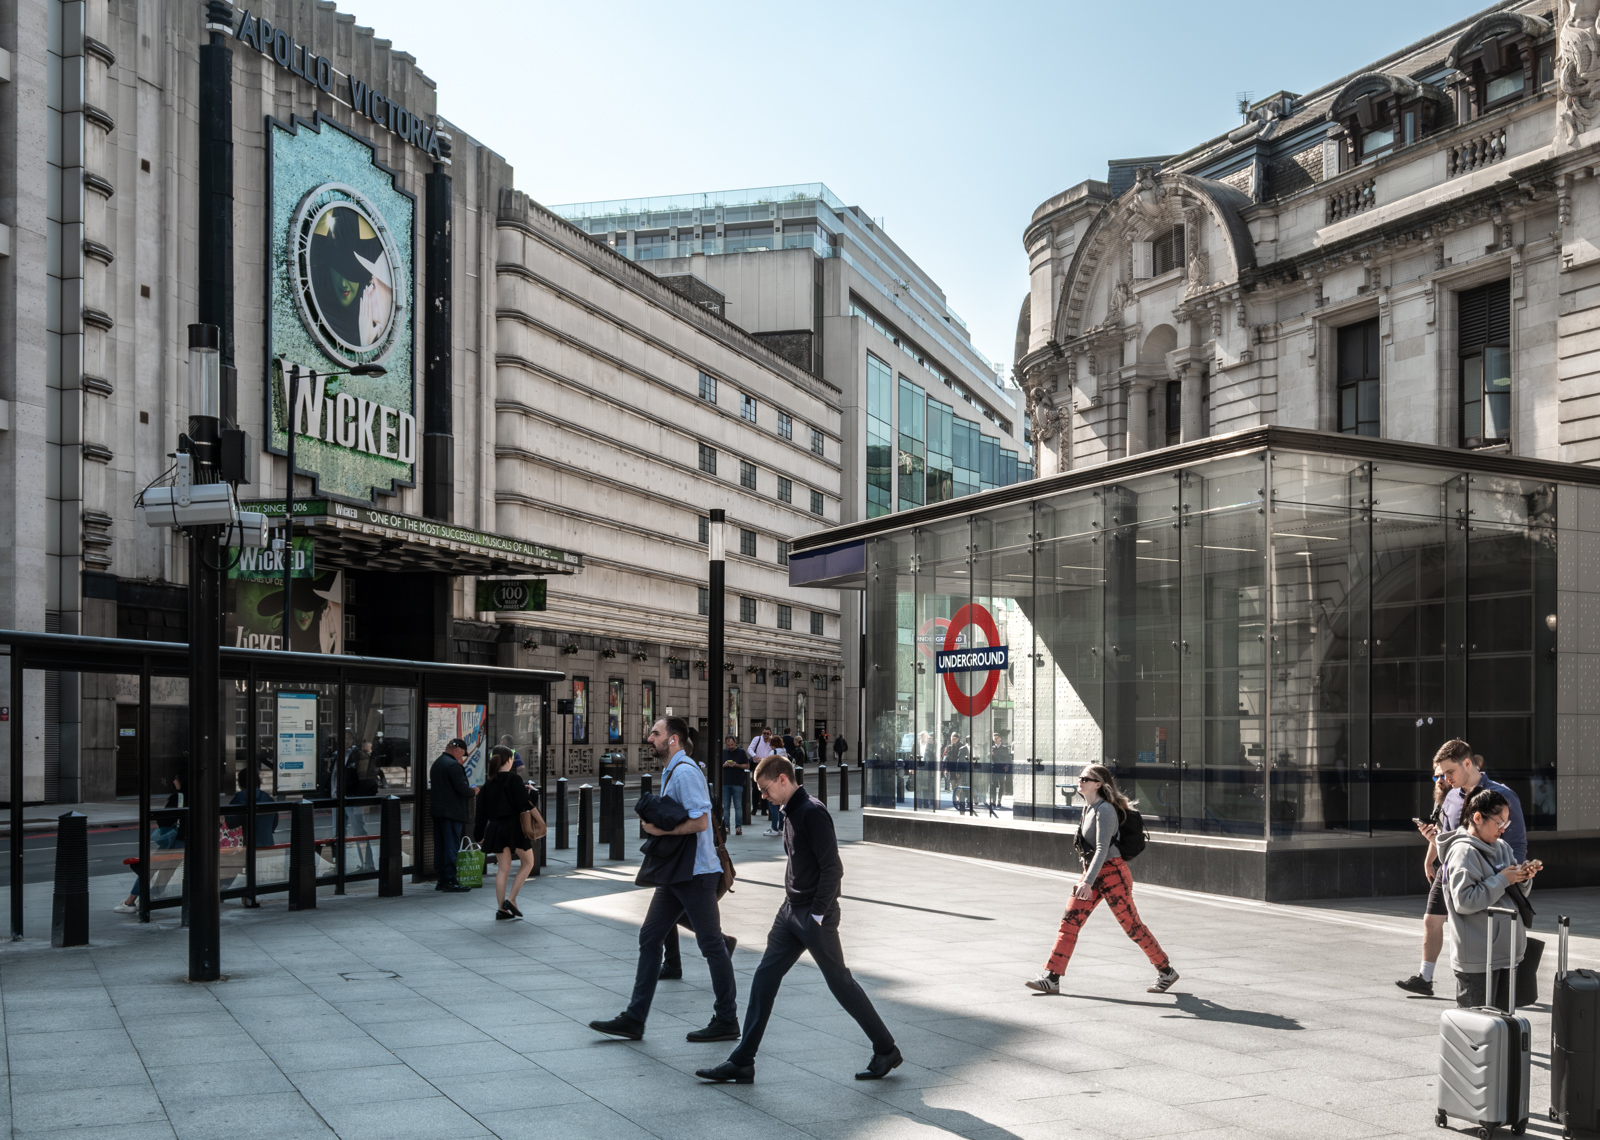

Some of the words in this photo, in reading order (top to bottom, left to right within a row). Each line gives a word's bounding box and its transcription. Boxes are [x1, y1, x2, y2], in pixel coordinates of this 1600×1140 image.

[236, 9, 332, 93] APOLLO
[347, 74, 442, 160] VICTORIA
[263, 504, 287, 513] SINCE
[292, 503, 308, 512] 006
[390, 515, 402, 528] OF
[403, 518, 418, 531] THE
[420, 521, 440, 535] MOST
[441, 526, 481, 544] SUCCESSFUL
[482, 535, 512, 550] MUSICALS
[513, 541, 522, 552] OF
[523, 544, 534, 555] ALL
[274, 577, 283, 586] OZ
[501, 586, 523, 600] 100
[938, 651, 1005, 669] UNDERGROUND
